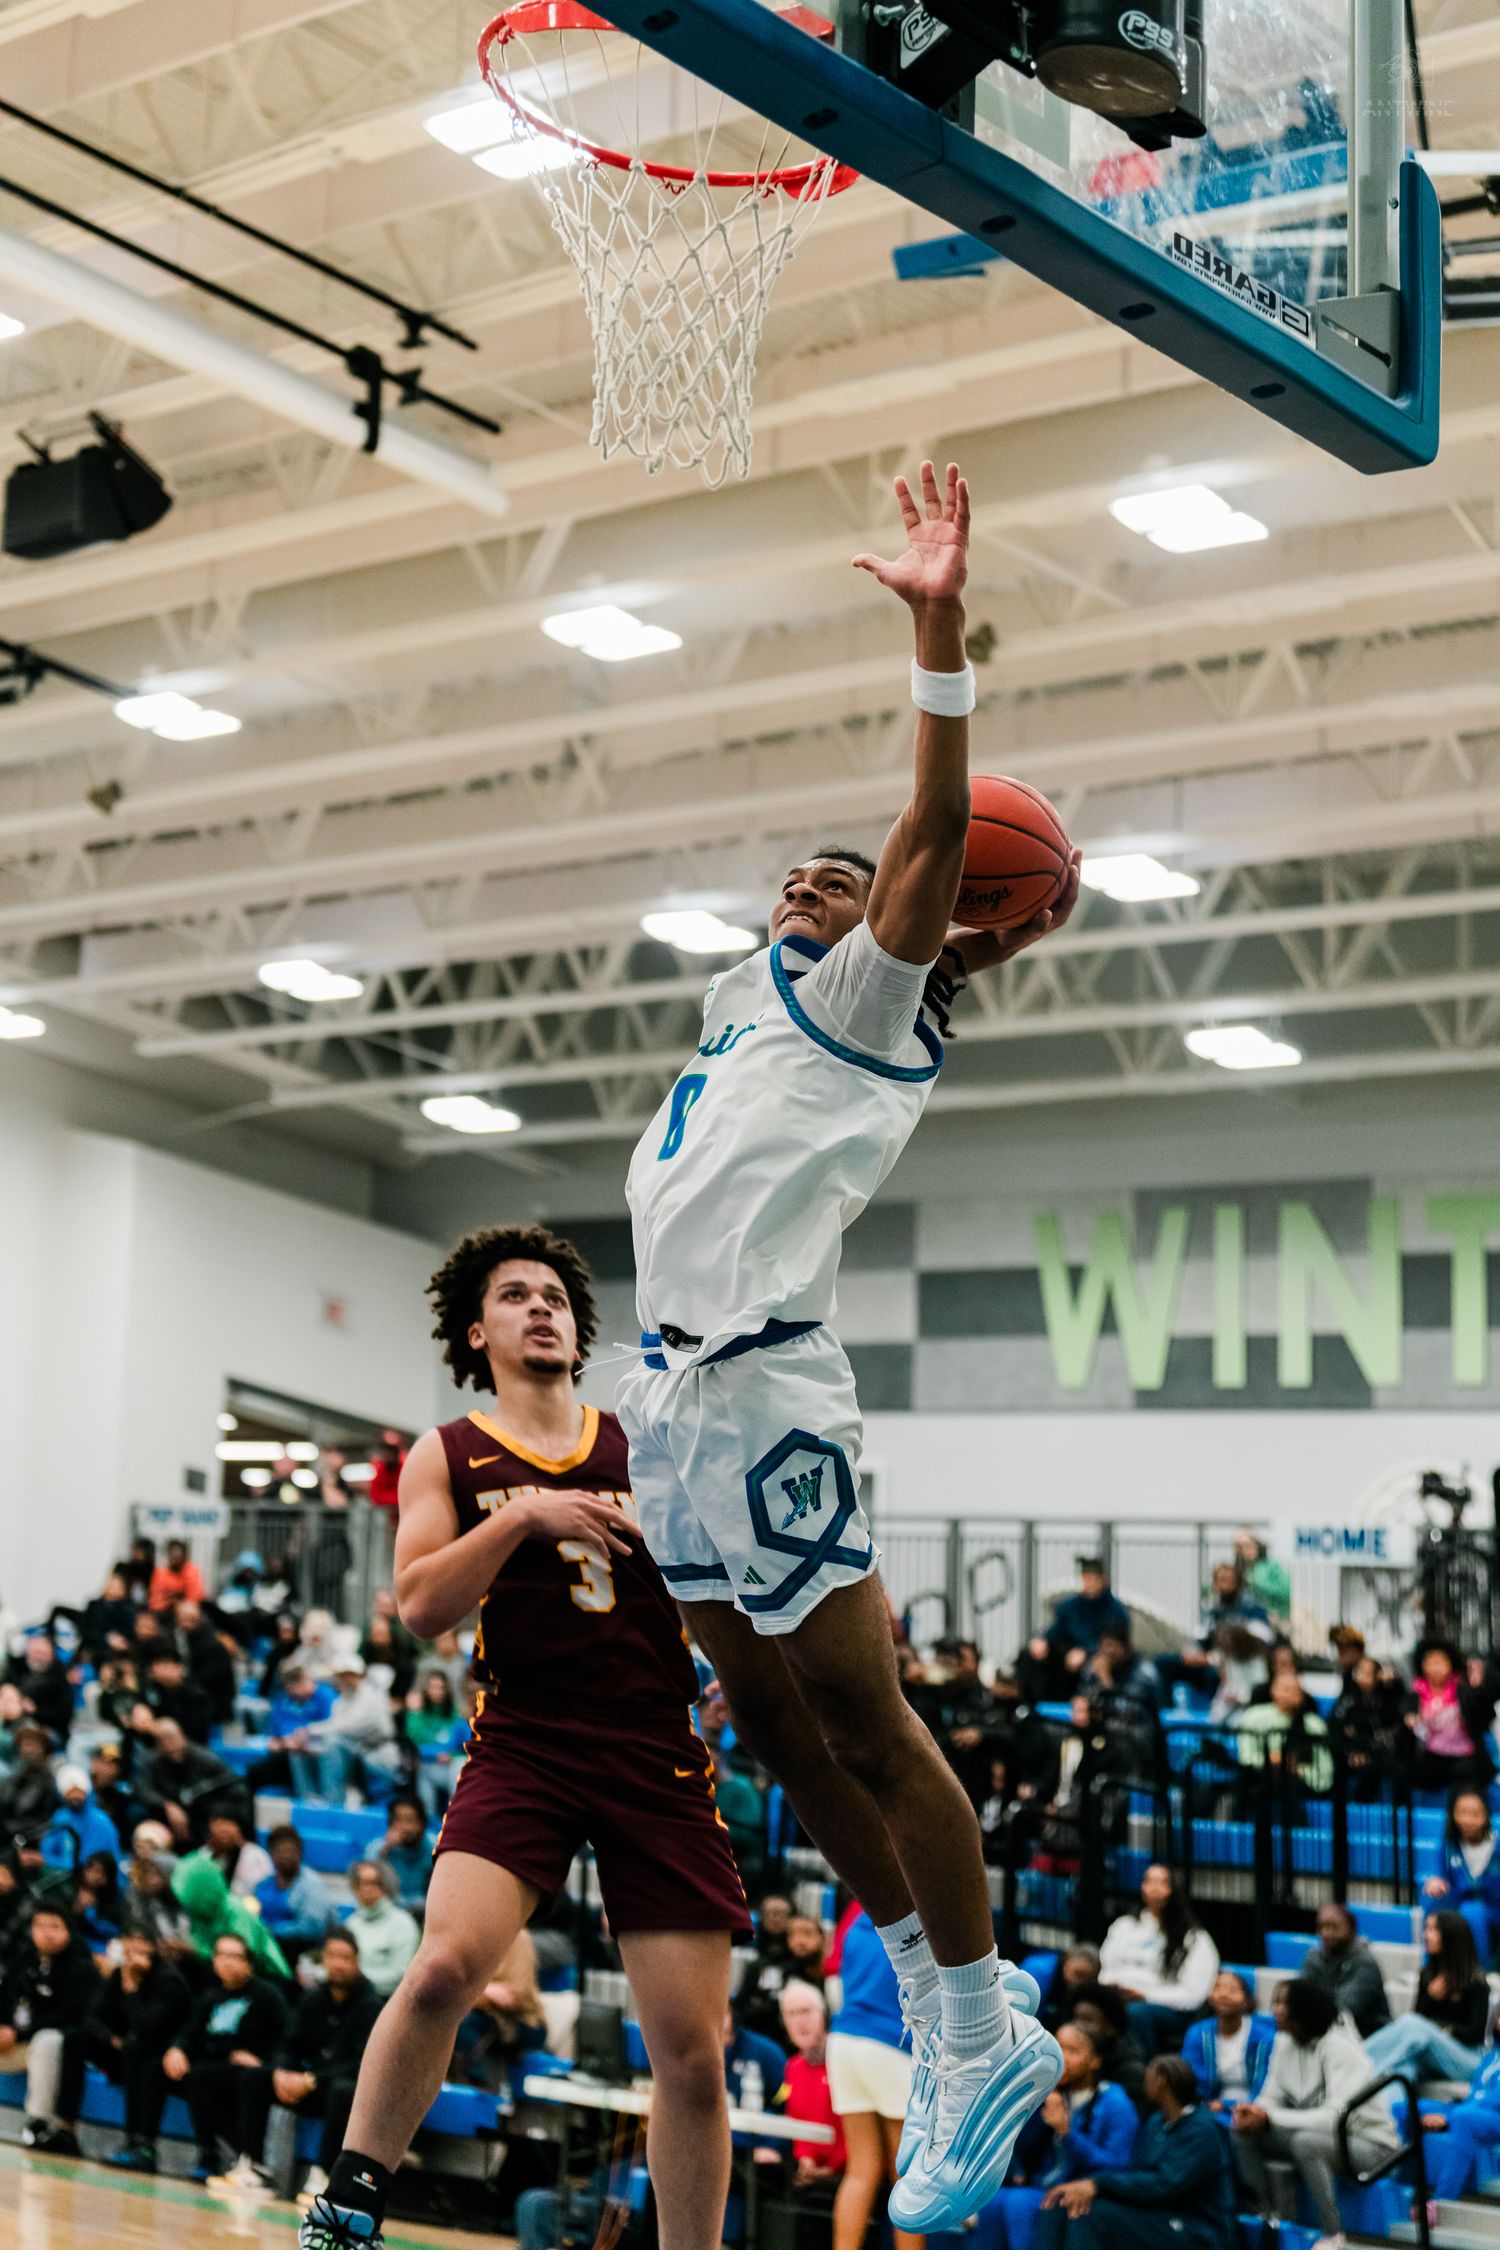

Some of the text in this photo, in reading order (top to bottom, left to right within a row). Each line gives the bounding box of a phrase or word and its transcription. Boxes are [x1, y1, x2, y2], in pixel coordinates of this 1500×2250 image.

[958, 886, 1013, 912] lings
[1034, 1195, 1500, 1391] WINT
[1296, 1527, 1387, 1559] HOME
[557, 1541, 616, 1612] 3
